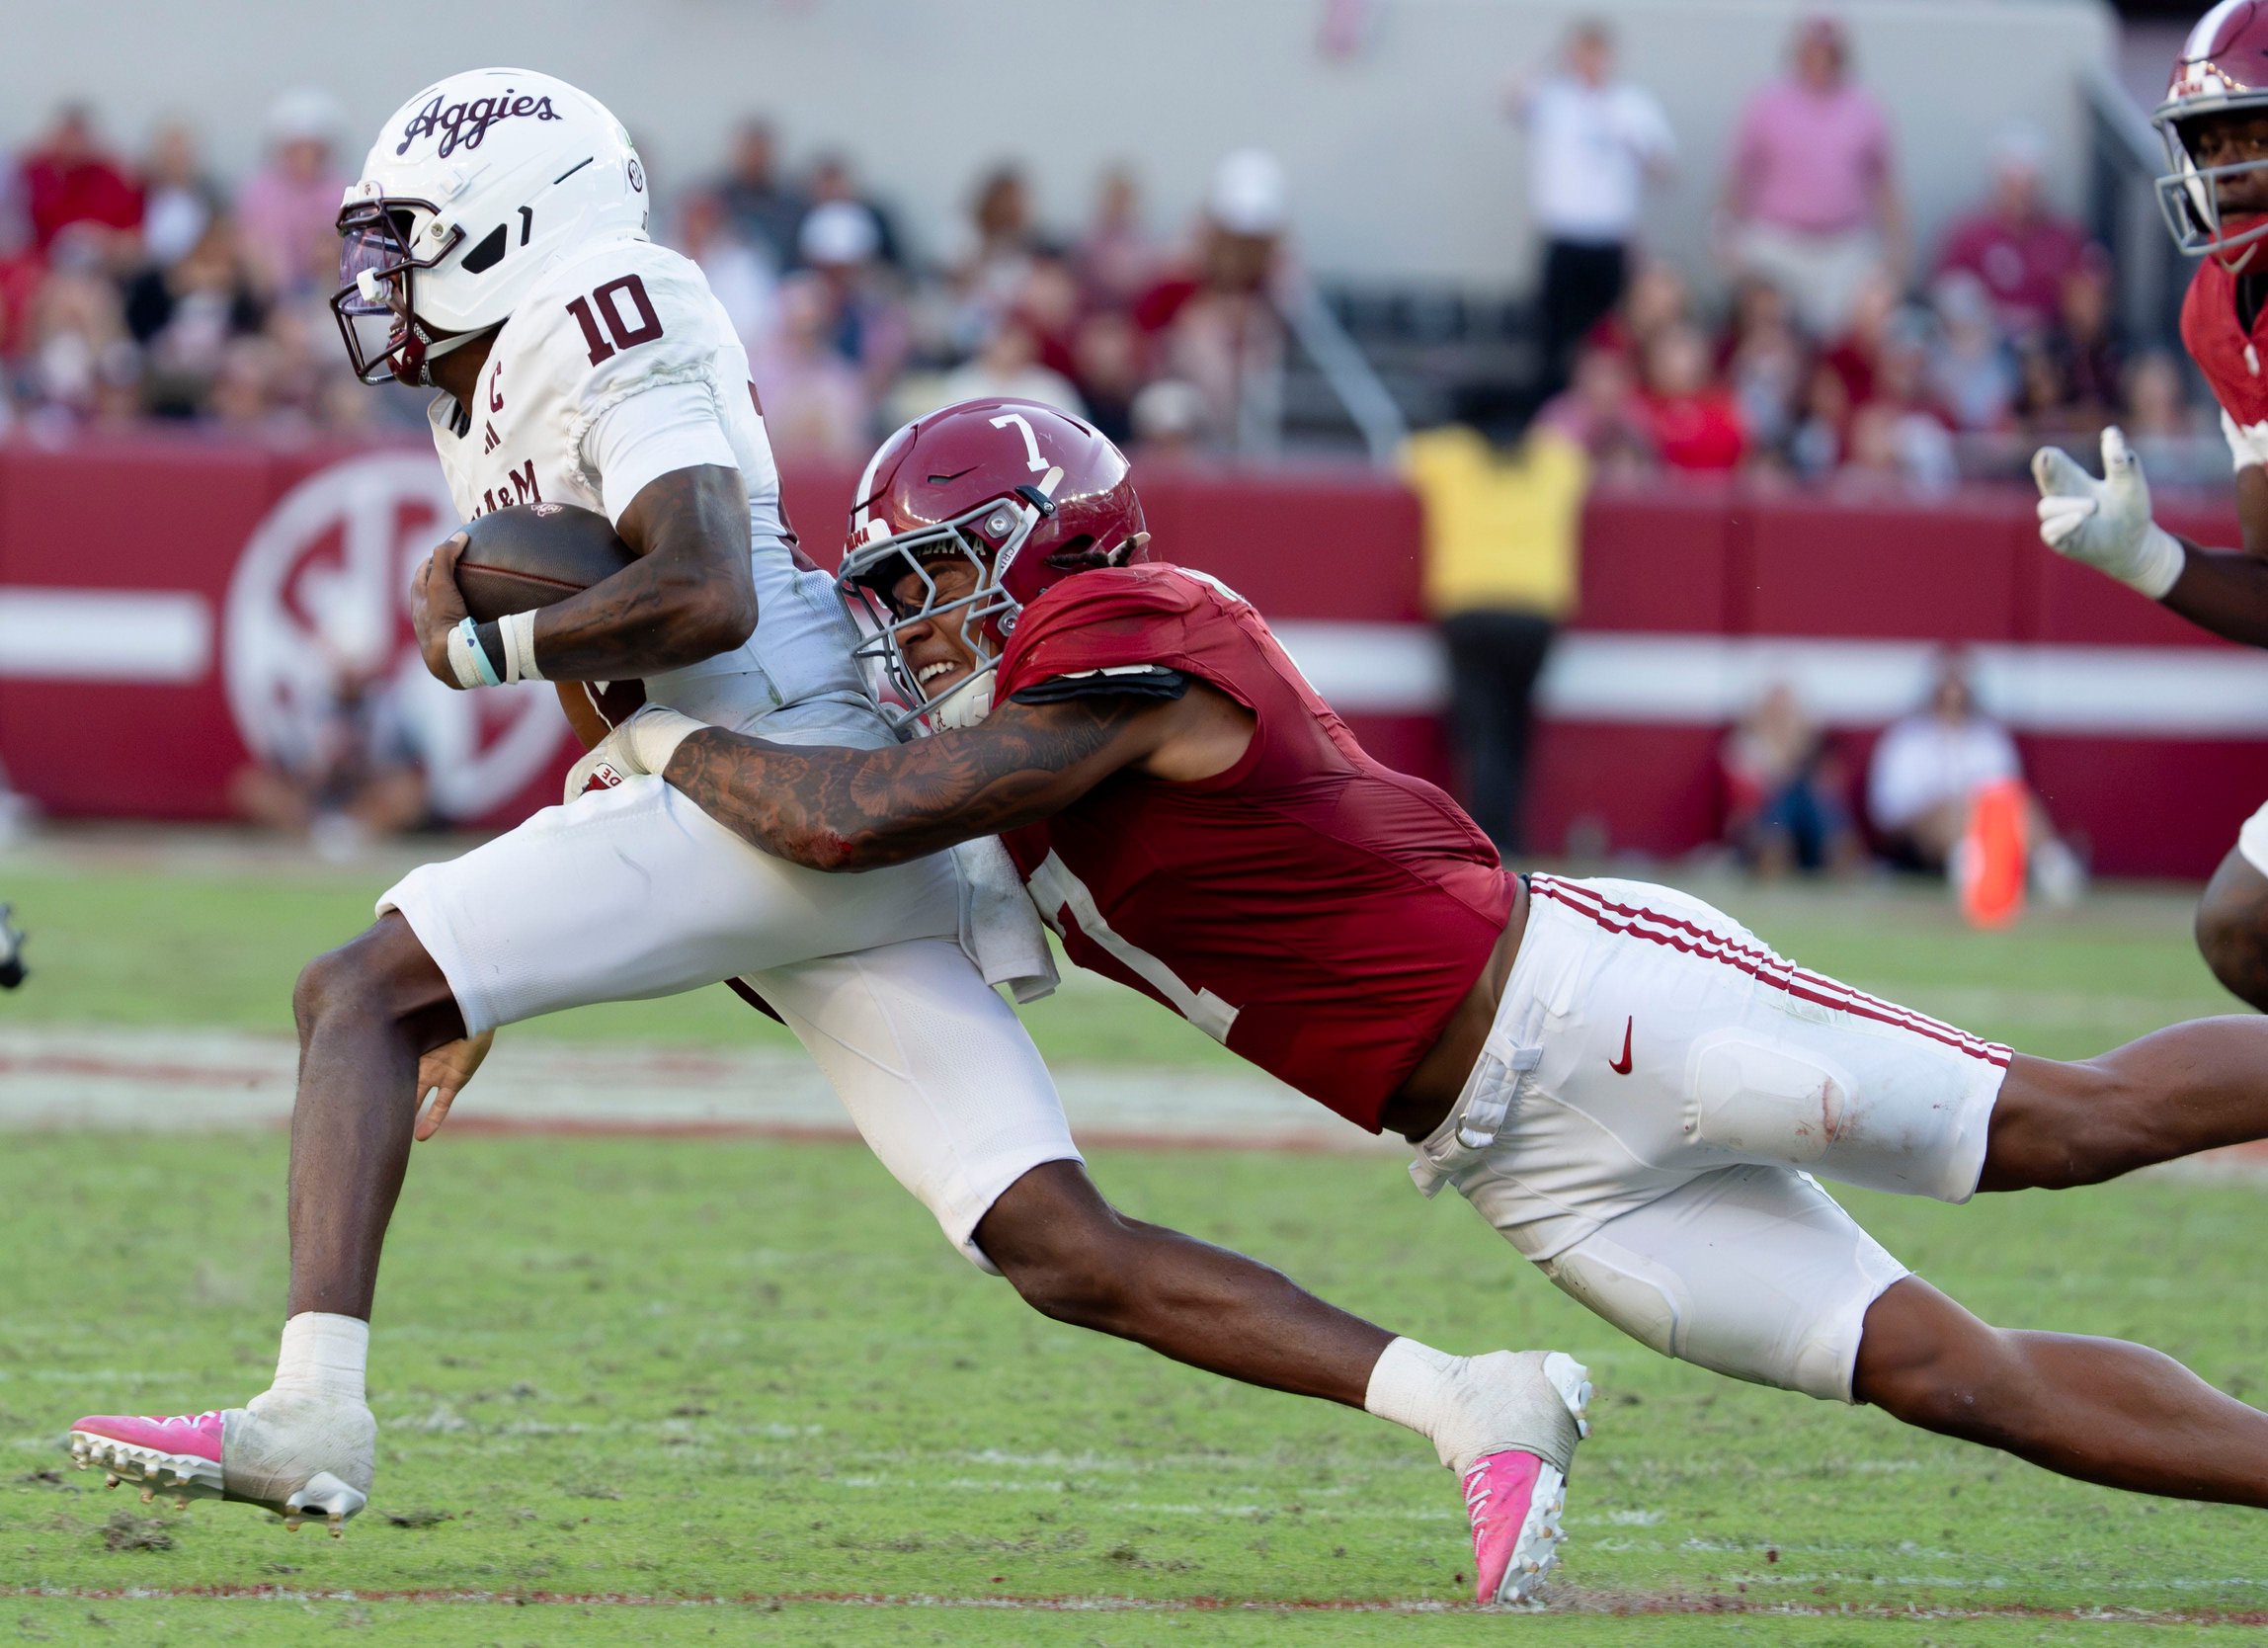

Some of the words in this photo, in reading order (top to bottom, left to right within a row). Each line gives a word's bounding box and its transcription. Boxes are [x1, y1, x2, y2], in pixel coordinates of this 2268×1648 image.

[396, 88, 563, 159] Aggies
[565, 273, 664, 368] 10
[489, 360, 505, 414] C
[988, 413, 1050, 472] 7
